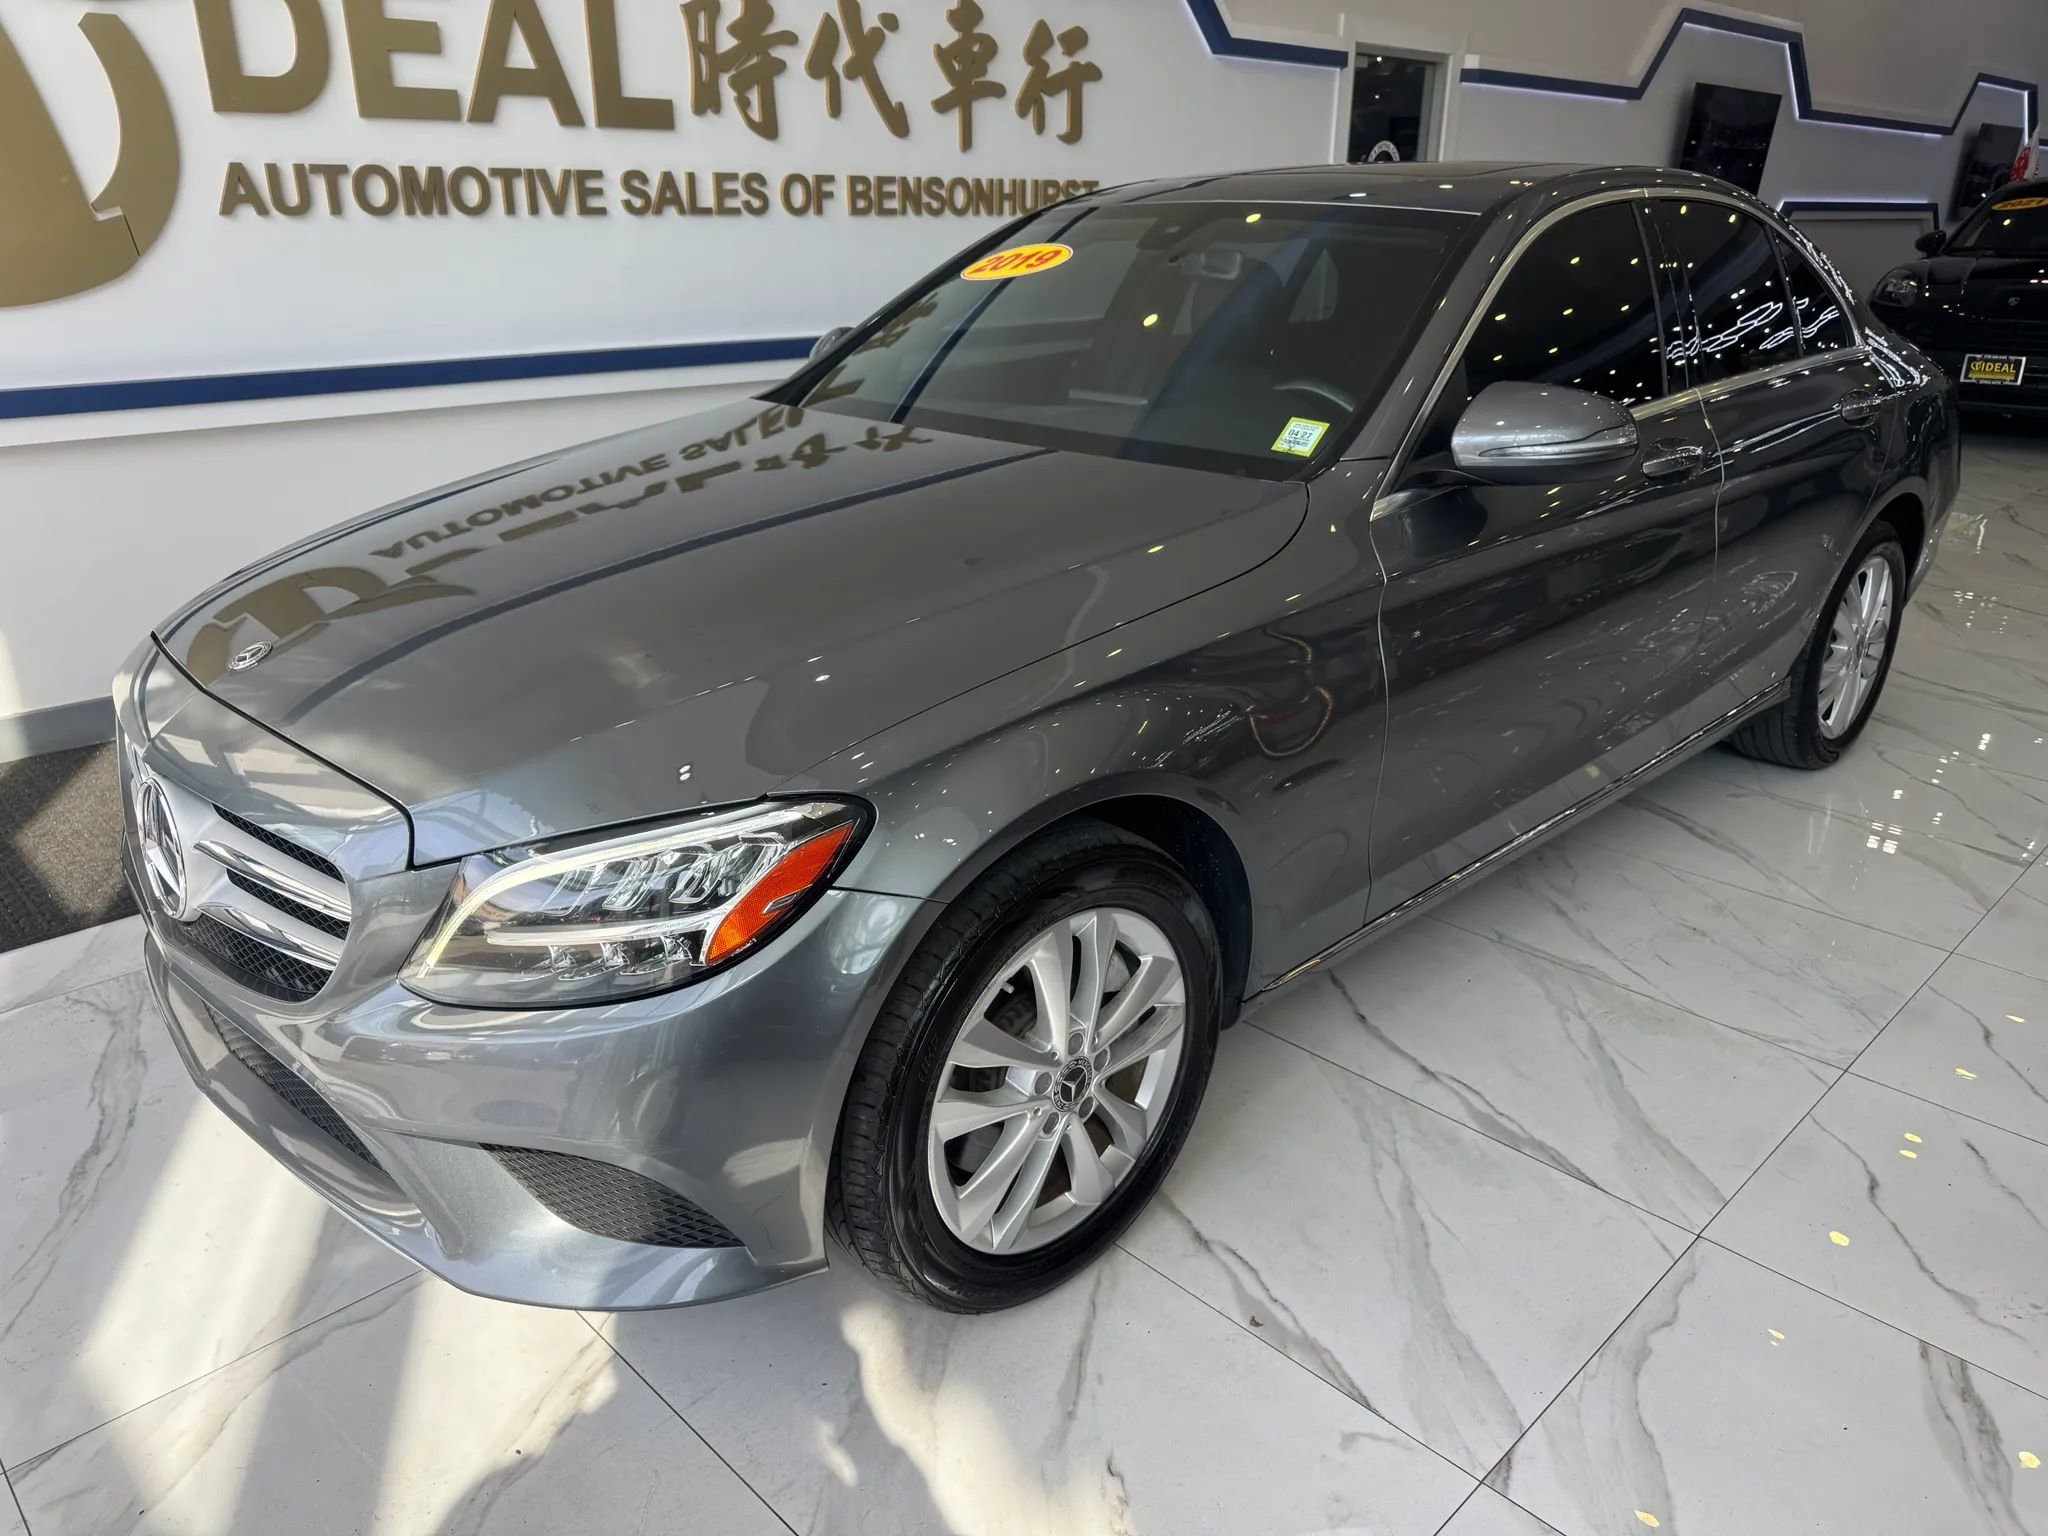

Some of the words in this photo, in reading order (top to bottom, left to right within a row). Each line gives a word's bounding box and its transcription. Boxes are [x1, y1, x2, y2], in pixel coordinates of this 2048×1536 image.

[680, 0, 1102, 152] 時代車行
[218, 162, 608, 216] AUTOMOTIVE
[620, 169, 770, 216] SALES
[780, 173, 835, 216] OF
[966, 249, 1062, 275] 2019
[1981, 361, 2017, 374] IDEAL
